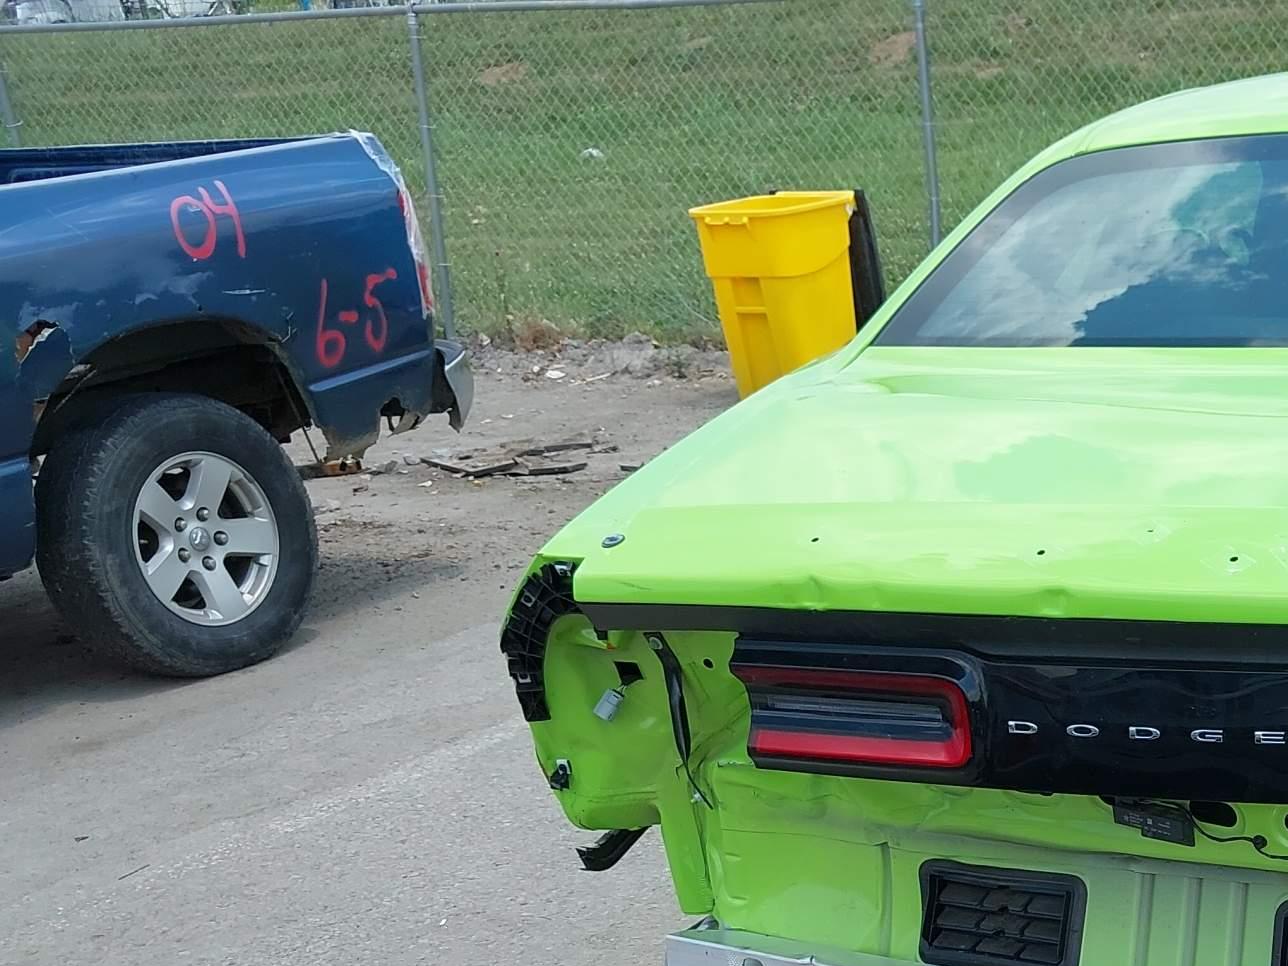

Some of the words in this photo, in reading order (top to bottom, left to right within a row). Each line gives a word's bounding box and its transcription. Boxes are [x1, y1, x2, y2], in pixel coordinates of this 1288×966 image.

[170, 180, 246, 260] 04
[316, 268, 397, 368] 6-5
[1007, 720, 1286, 745] DODGE
